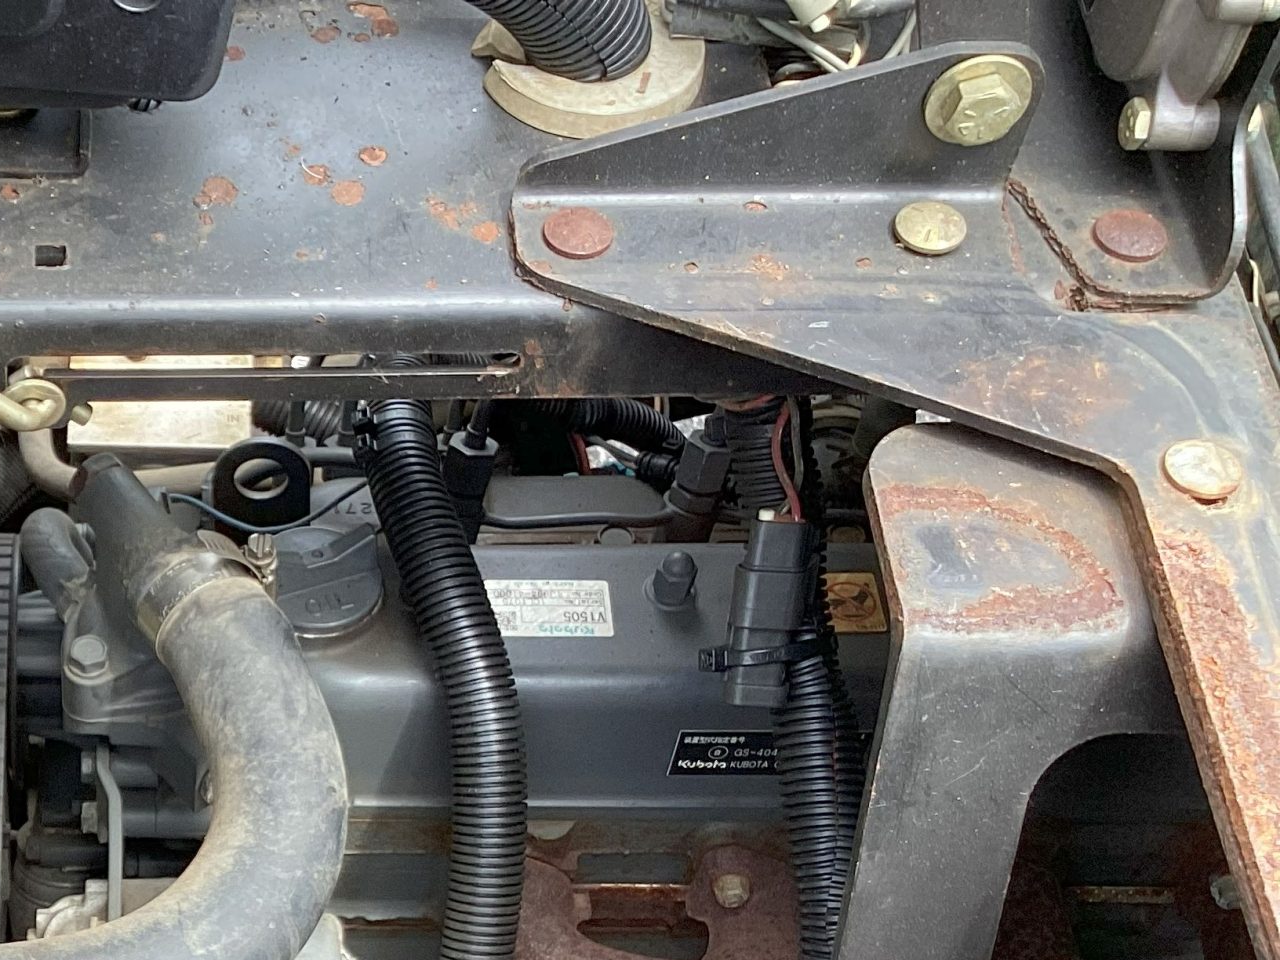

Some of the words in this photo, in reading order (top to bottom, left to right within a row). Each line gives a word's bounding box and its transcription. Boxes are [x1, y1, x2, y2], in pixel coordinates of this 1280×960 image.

[304, 592, 355, 617] OIL
[563, 611, 607, 622] V1505
[677, 759, 727, 769] Kubota
[729, 760, 769, 769] KUBOTA
